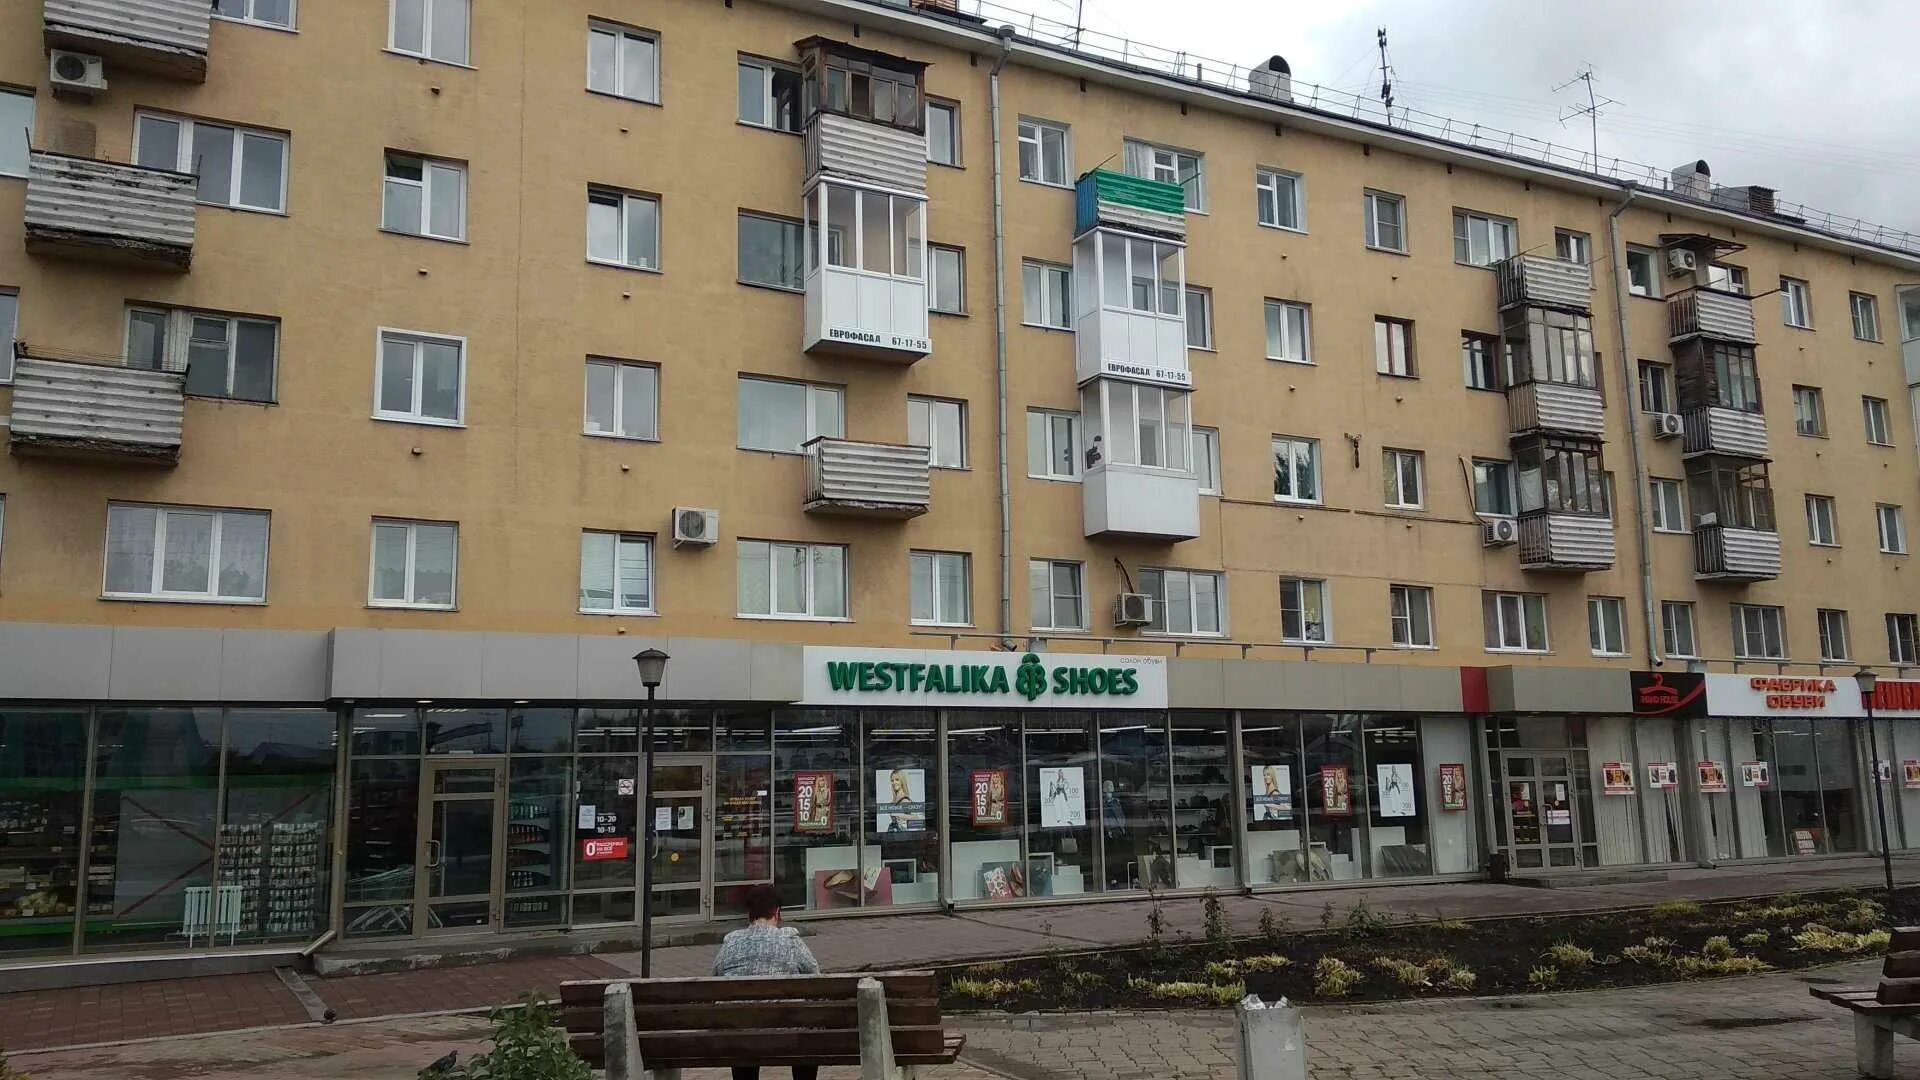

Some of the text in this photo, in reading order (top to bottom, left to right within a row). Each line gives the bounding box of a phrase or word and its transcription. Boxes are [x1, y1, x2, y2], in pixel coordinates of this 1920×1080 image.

[829, 328, 927, 349] ЕВРОФАСАД 67-17-55
[1107, 363, 1186, 381] ЕВРОФАСАД 67-17-55
[827, 660, 1139, 696] WESTFALIKA SHOES
[1750, 677, 1837, 693] ФАБРИКА
[1766, 694, 1826, 709] ОБУВИ
[1323, 776, 1335, 787] 20
[1442, 774, 1453, 785] 20
[798, 785, 813, 798] 20
[975, 782, 988, 794] 20
[799, 798, 811, 811] 15
[976, 794, 987, 806] 15
[799, 811, 810, 821] 10
[977, 805, 986, 816] 10
[596, 815, 617, 823] 10-20
